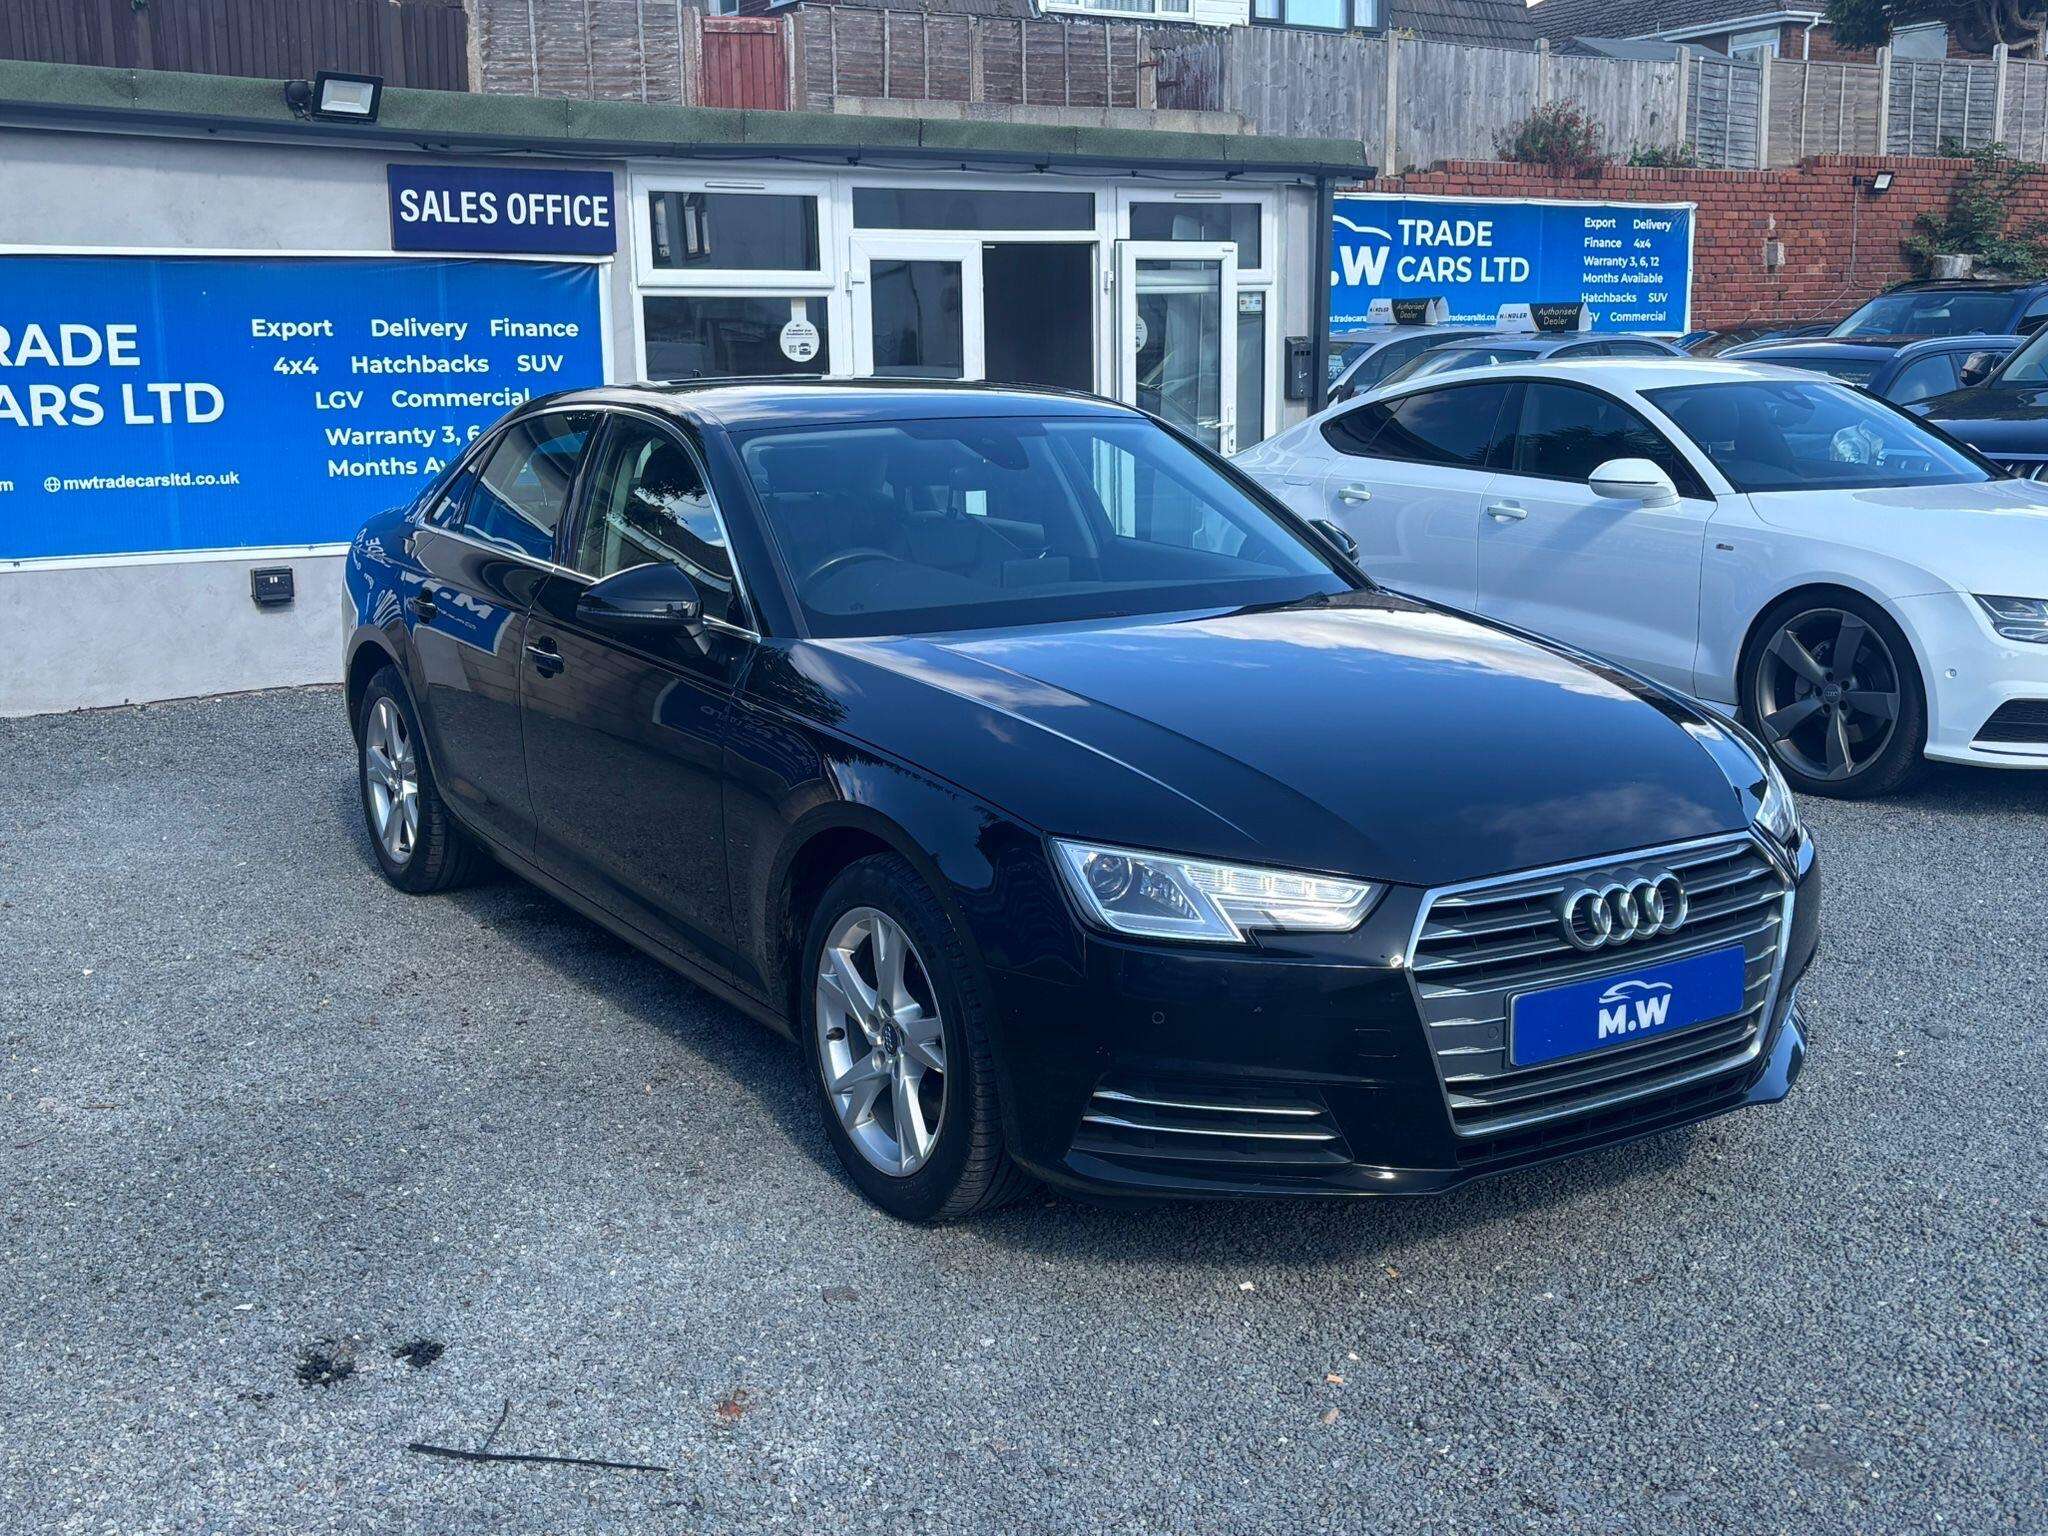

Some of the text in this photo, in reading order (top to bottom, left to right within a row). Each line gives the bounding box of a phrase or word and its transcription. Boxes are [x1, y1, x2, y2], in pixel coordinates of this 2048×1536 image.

[400, 189, 610, 227] SALES OFFICE
[1397, 219, 1493, 247] TRADE
[1584, 217, 1672, 232] Export Delivery
[1584, 237, 1652, 248] Finance 4x4
[1397, 256, 1530, 283] CARS LTD
[1583, 255, 1628, 268] Warranty
[1650, 256, 1660, 267] 12
[1582, 272, 1664, 283] Months Available
[1581, 292, 1668, 303] Hatchbacks SUV
[1538, 307, 1578, 316] Authorised
[1543, 316, 1568, 325] Dealer
[1610, 311, 1666, 321] Commercial
[251, 318, 579, 341] Export Delivery Finance
[273, 354, 563, 375] 4x4 Hatchbacks SUV
[0, 382, 225, 427] ARS LTD
[315, 388, 530, 409] LGV Commercial
[325, 427, 436, 448] Warranty
[442, 426, 461, 446] 3,
[328, 457, 418, 477] Months
[64, 471, 240, 491] mwtradecarsltd.co.uk
[1598, 993, 1672, 1039] M.W
